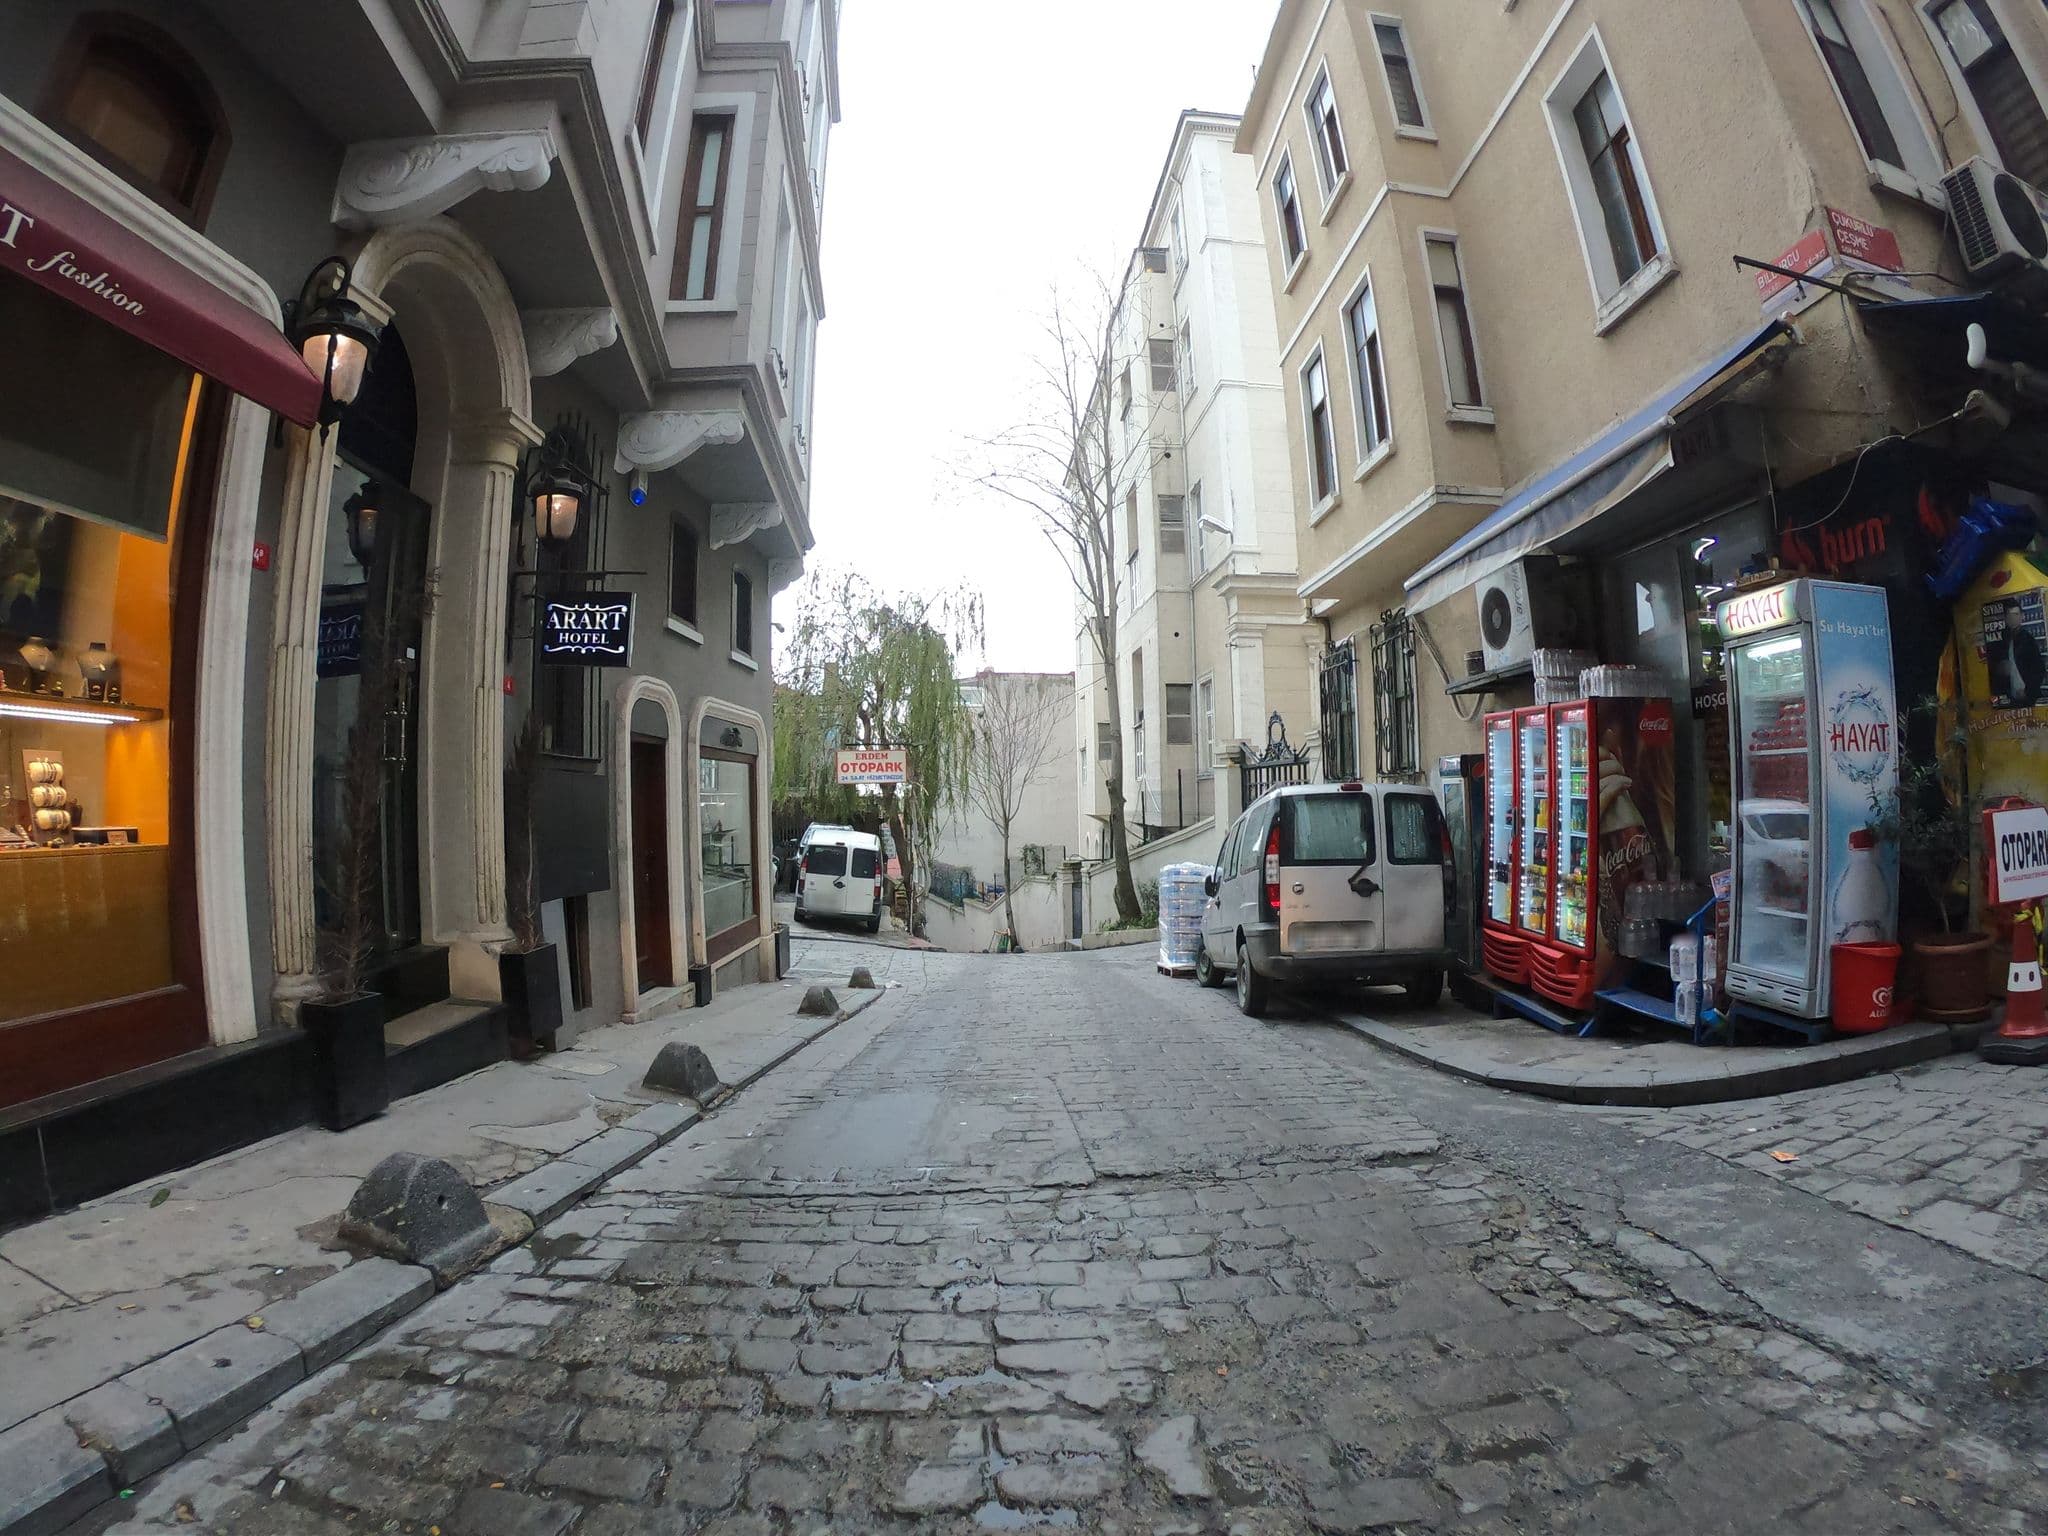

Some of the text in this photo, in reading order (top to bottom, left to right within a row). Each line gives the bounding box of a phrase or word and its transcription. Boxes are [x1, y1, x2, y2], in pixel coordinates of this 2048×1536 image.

[27, 251, 145, 316] fashion
[1819, 517, 1886, 569] burn
[1726, 588, 1785, 631] HAYAT
[546, 611, 626, 631] ARART
[1820, 620, 1834, 634] Su
[1984, 619, 2006, 633] PEPSI
[559, 632, 610, 645] HOTEL
[1830, 723, 1889, 752] HAYAT
[855, 752, 888, 761] ERDEM
[840, 761, 904, 774] OTOPARK
